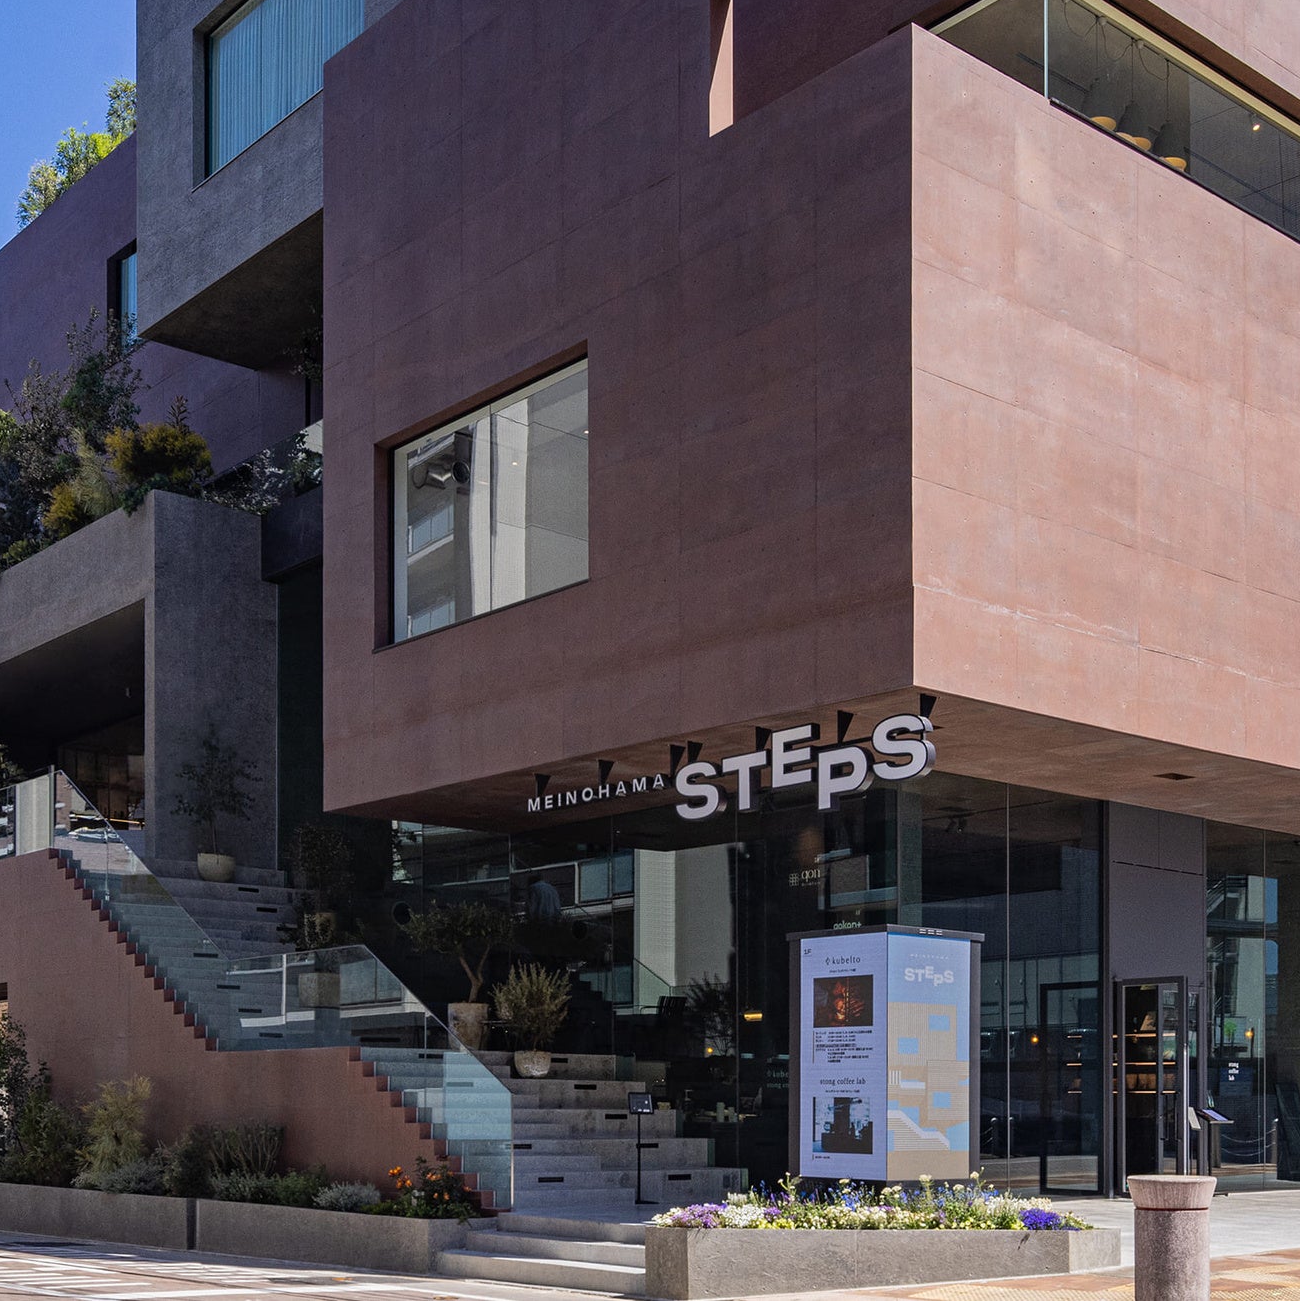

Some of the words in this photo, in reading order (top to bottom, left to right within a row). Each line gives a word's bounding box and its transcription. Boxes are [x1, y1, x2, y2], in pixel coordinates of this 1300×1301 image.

[527, 773, 665, 813] MEINOHAMA
[675, 714, 934, 821] STEPS
[904, 965, 955, 987] STEPS
